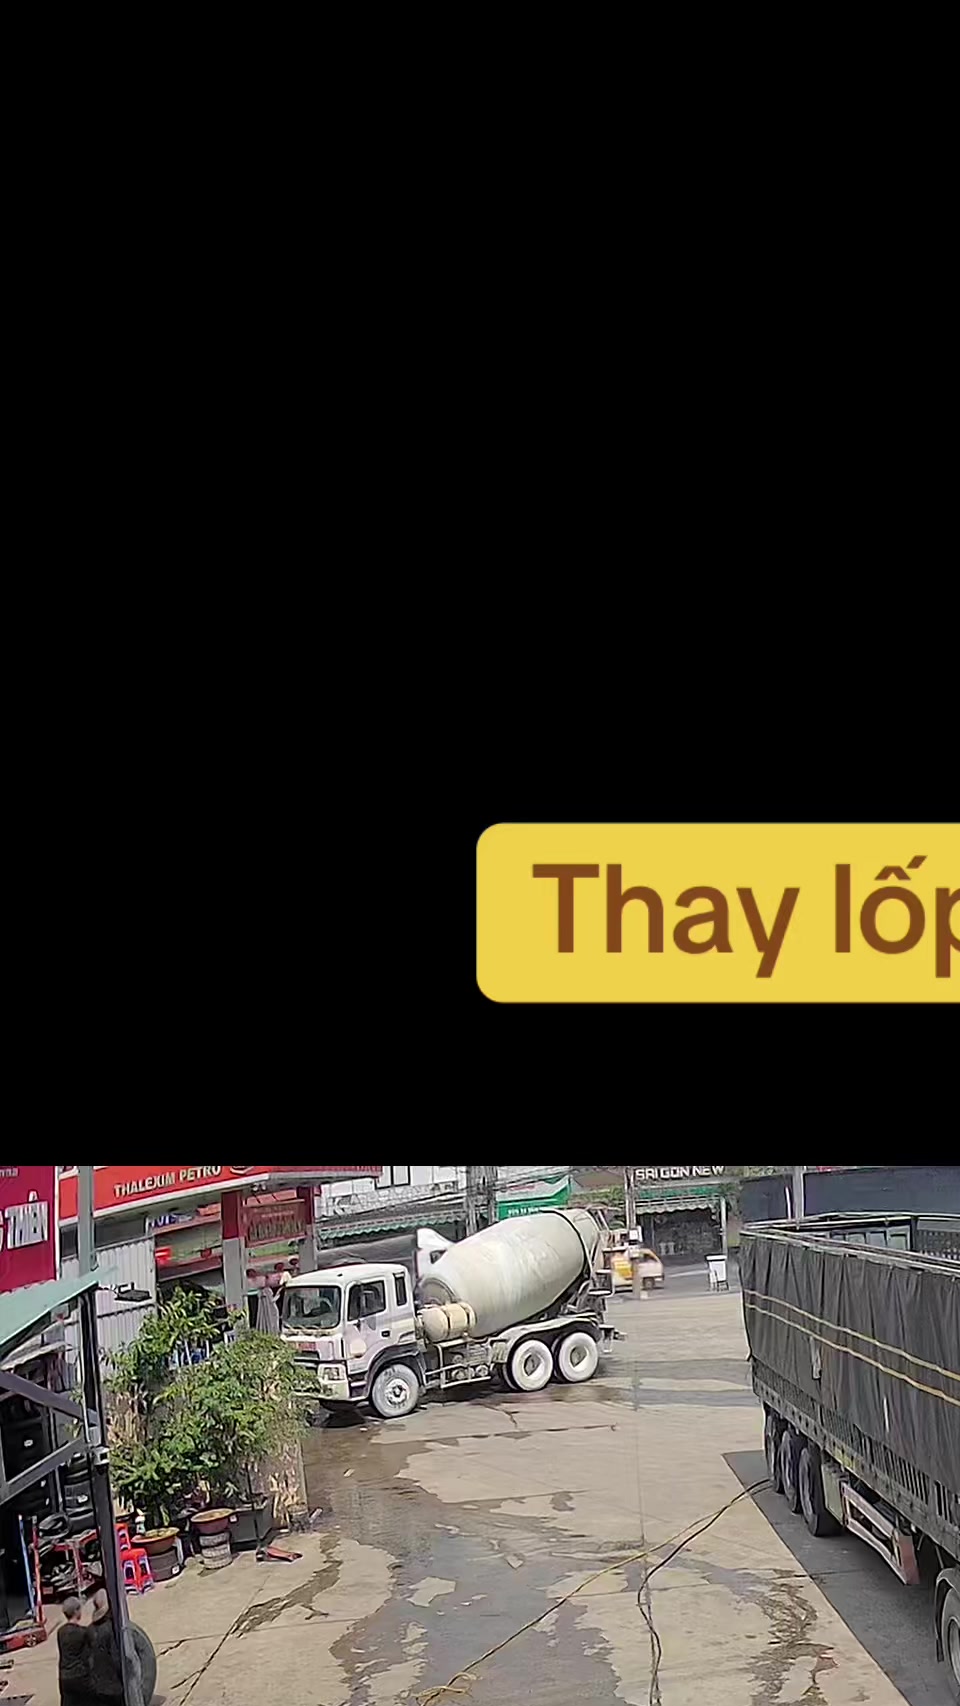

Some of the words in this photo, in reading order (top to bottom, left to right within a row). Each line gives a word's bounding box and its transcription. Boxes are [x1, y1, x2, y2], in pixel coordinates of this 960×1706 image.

[113, 1172, 176, 1198] THALEXIM
[179, 1165, 222, 1183] PETRO
[692, 1165, 725, 1177] NEW
